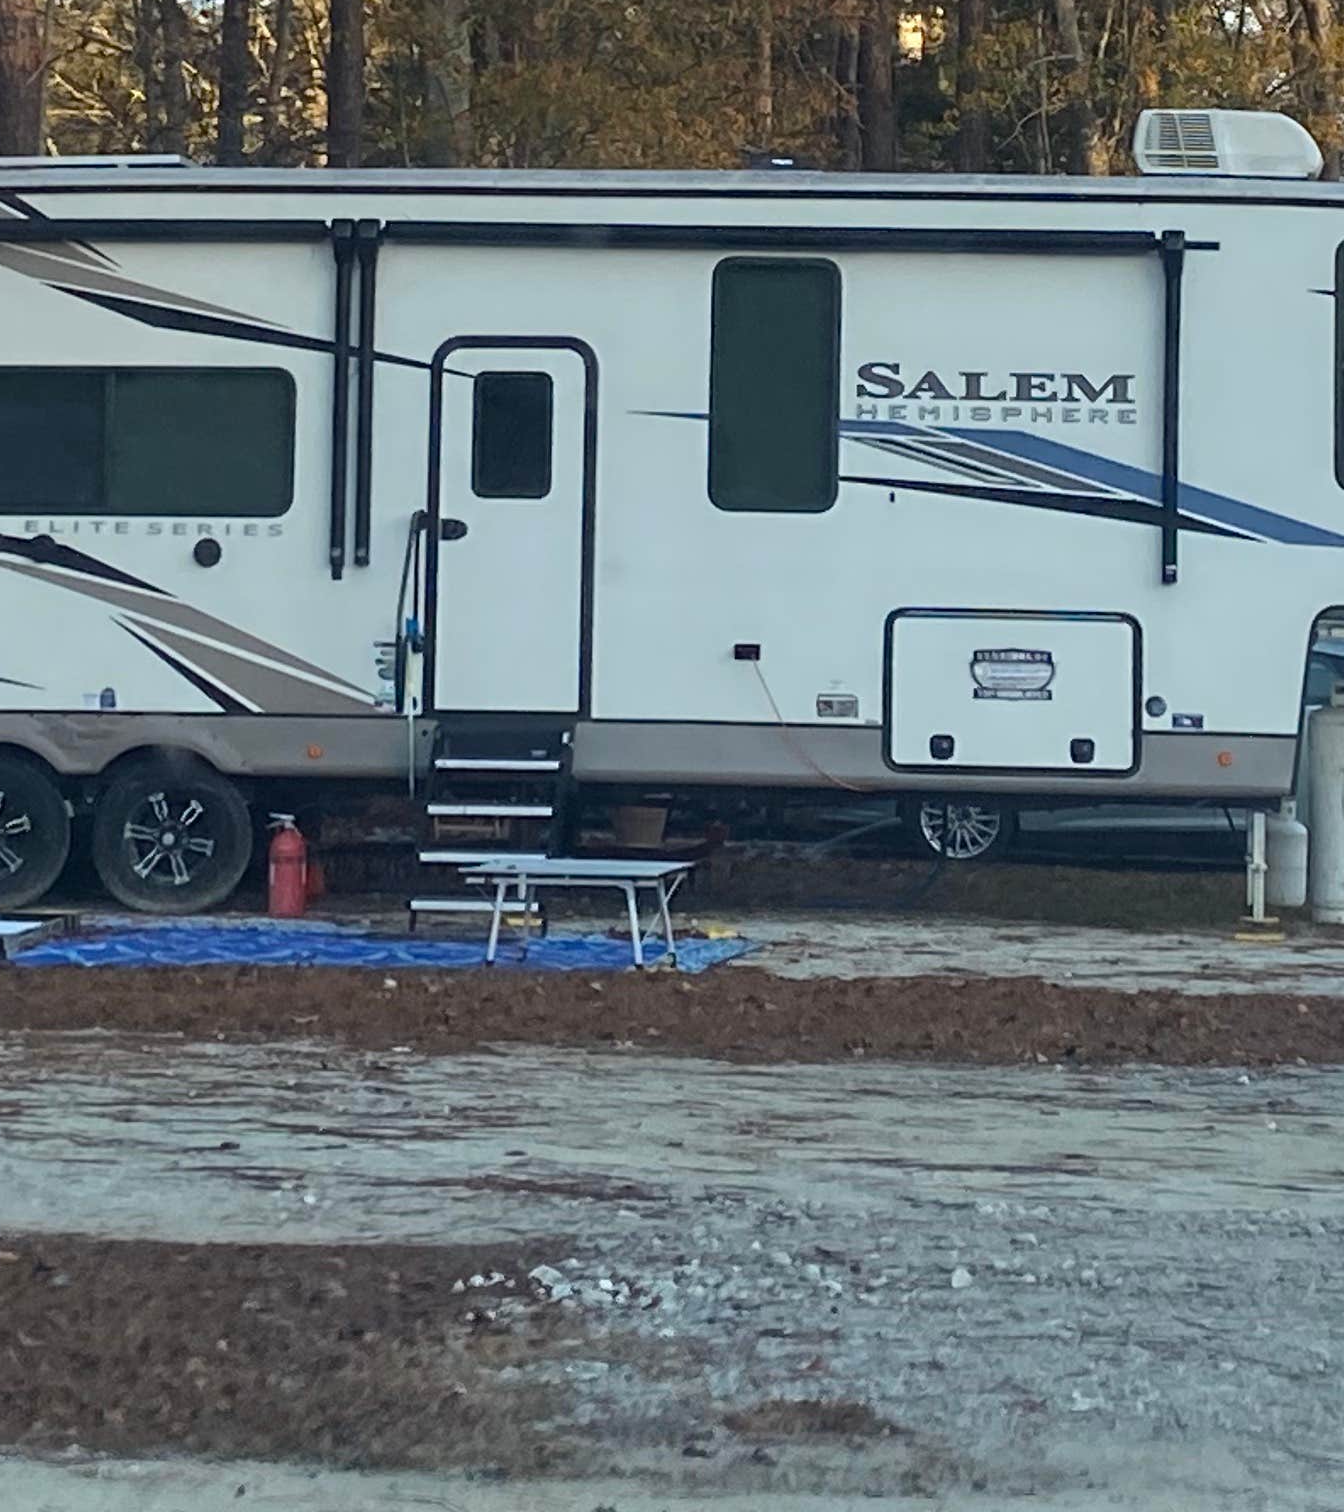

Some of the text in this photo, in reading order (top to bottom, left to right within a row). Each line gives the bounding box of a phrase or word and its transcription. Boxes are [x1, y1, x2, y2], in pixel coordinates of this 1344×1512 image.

[856, 362, 1136, 403] SALEM
[856, 403, 1137, 424] HEMISPHERE
[24, 519, 283, 537] ELITE SERIES
